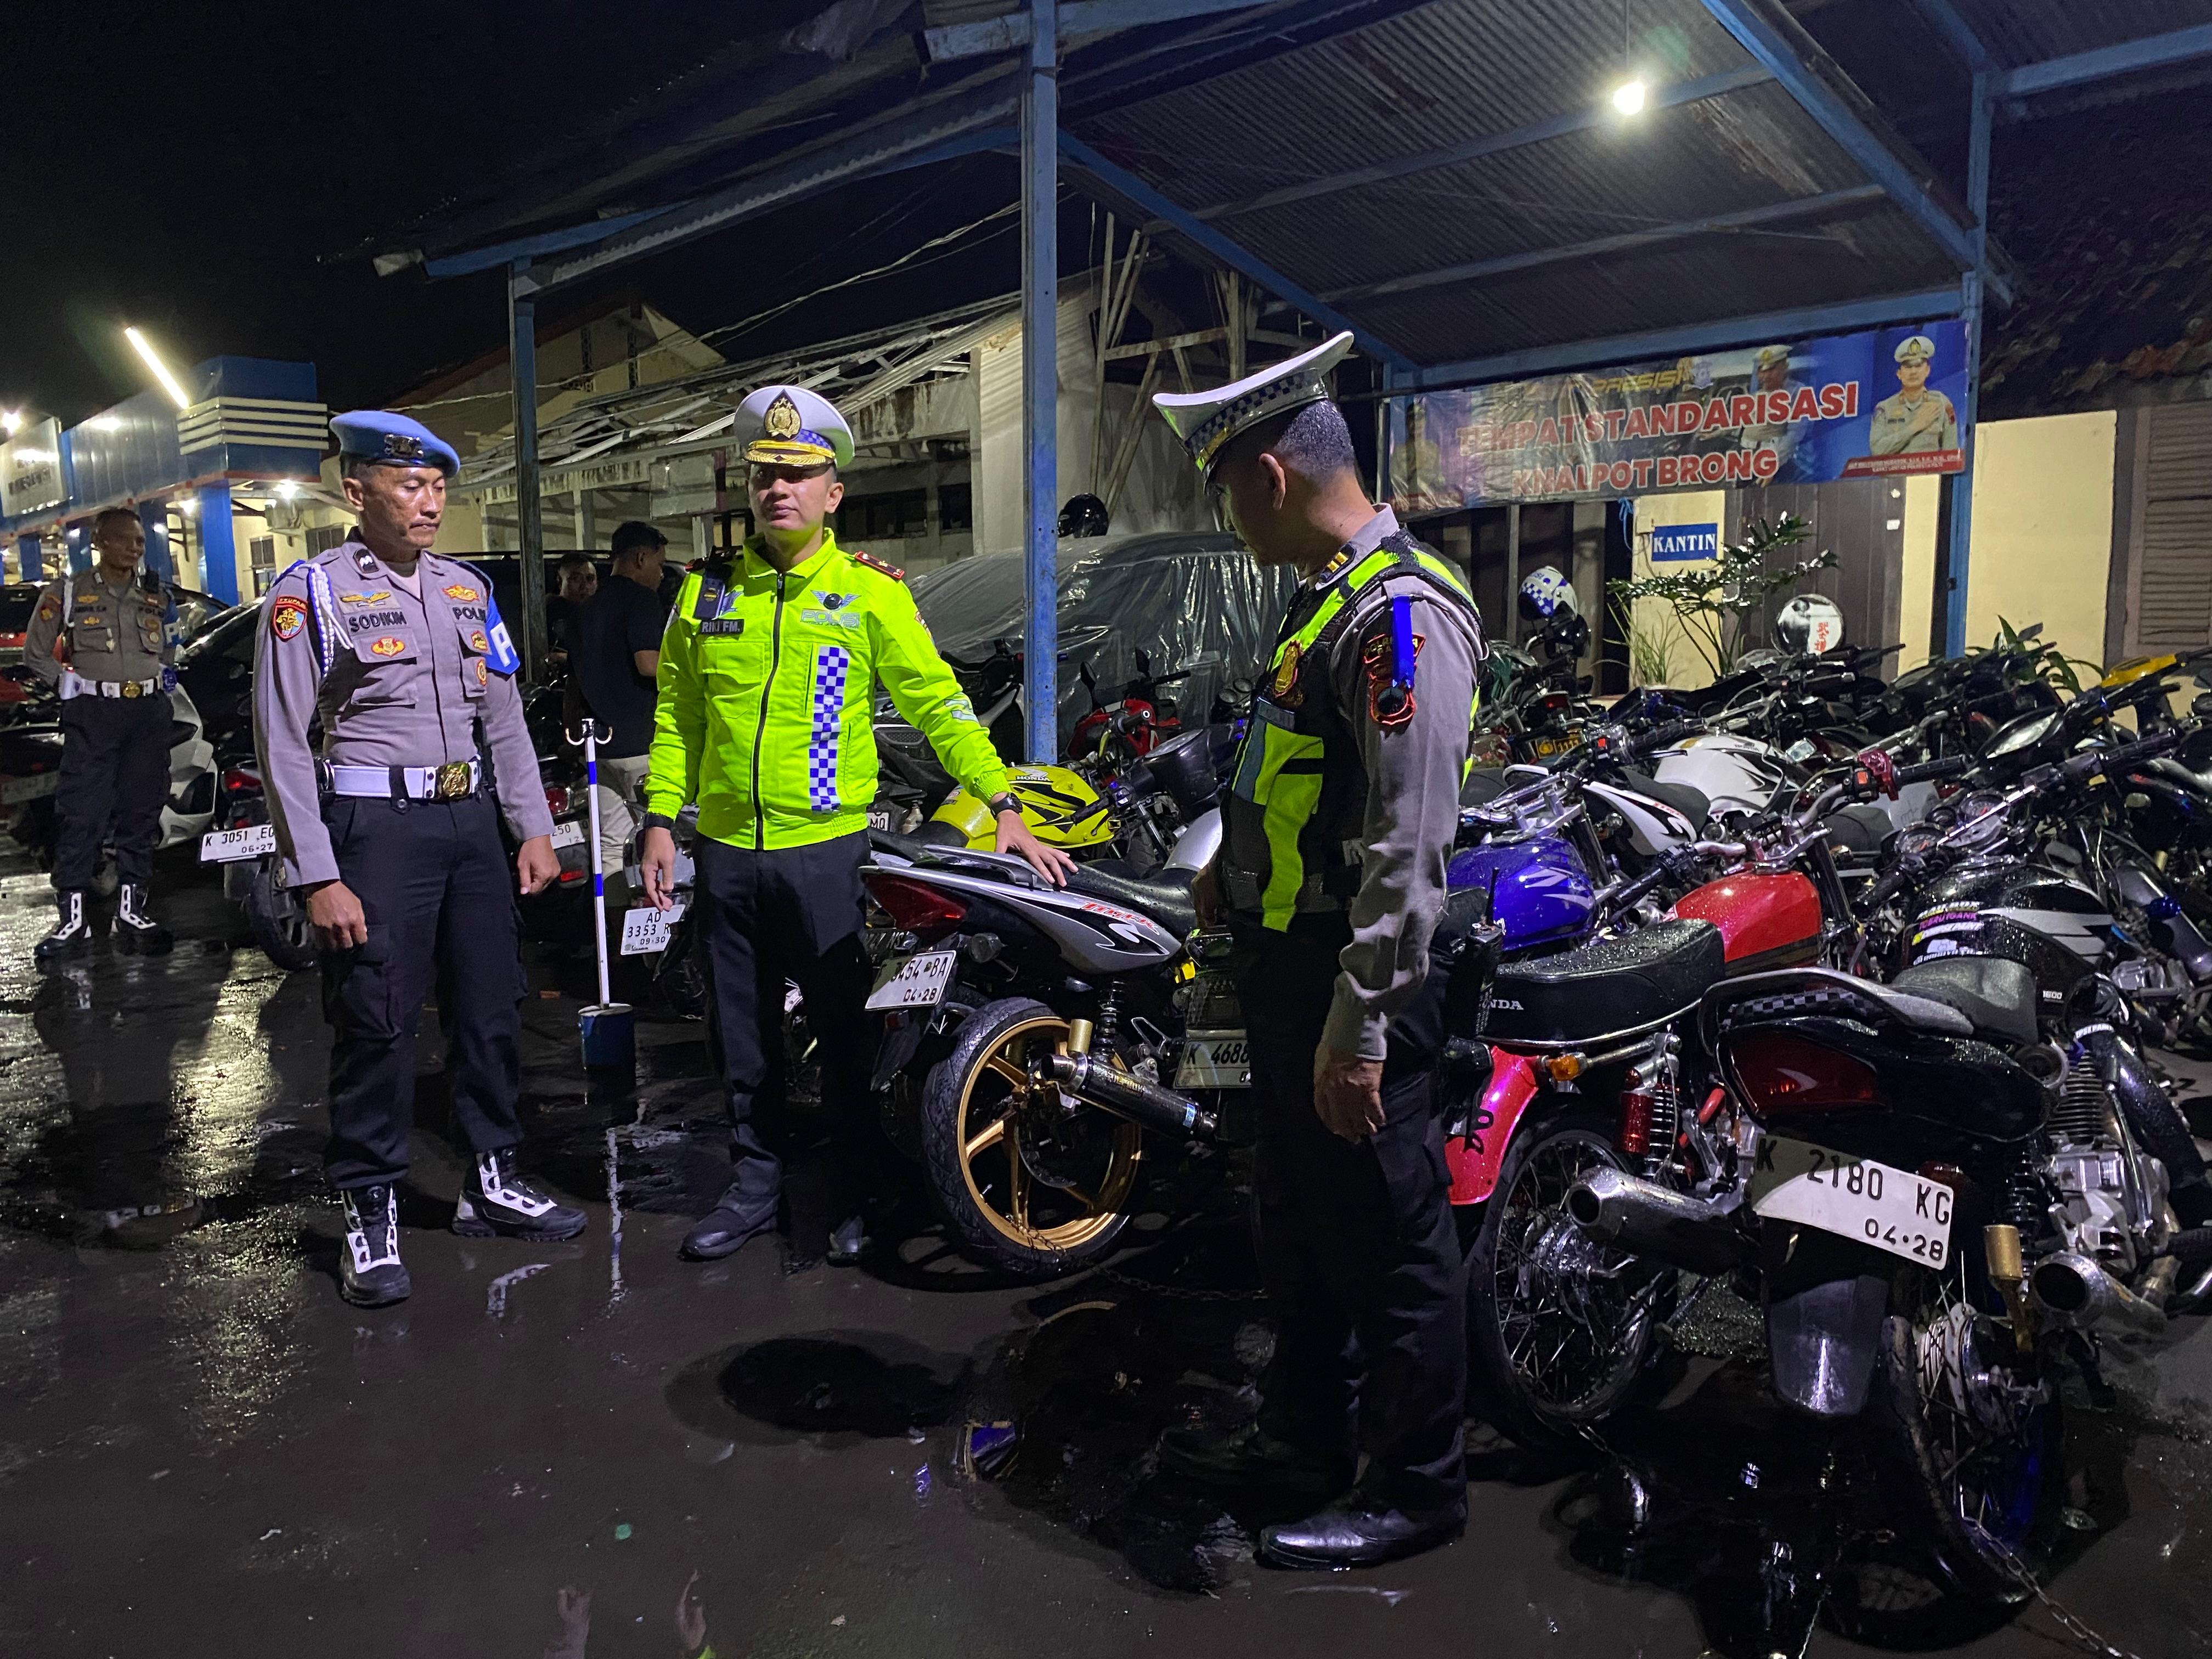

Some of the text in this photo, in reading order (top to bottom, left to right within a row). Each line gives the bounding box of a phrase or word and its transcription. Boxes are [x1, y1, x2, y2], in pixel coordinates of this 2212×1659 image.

[1457, 381, 1859, 456] TEMPAT STANDARISASI
[1512, 449, 1778, 497] KNALPOT BRONG
[1653, 533, 1716, 553] KANTIN
[349, 612, 407, 632] SODIKIN
[801, 609, 860, 627] POLISI
[205, 835, 213, 847] K
[222, 830, 248, 844] 3051
[646, 912, 662, 924] AD
[628, 924, 657, 938] 3353
[1490, 999, 1524, 1011] NDA
[1186, 1044, 1201, 1065] K
[1757, 1138, 1950, 1225] K 2180 KG
